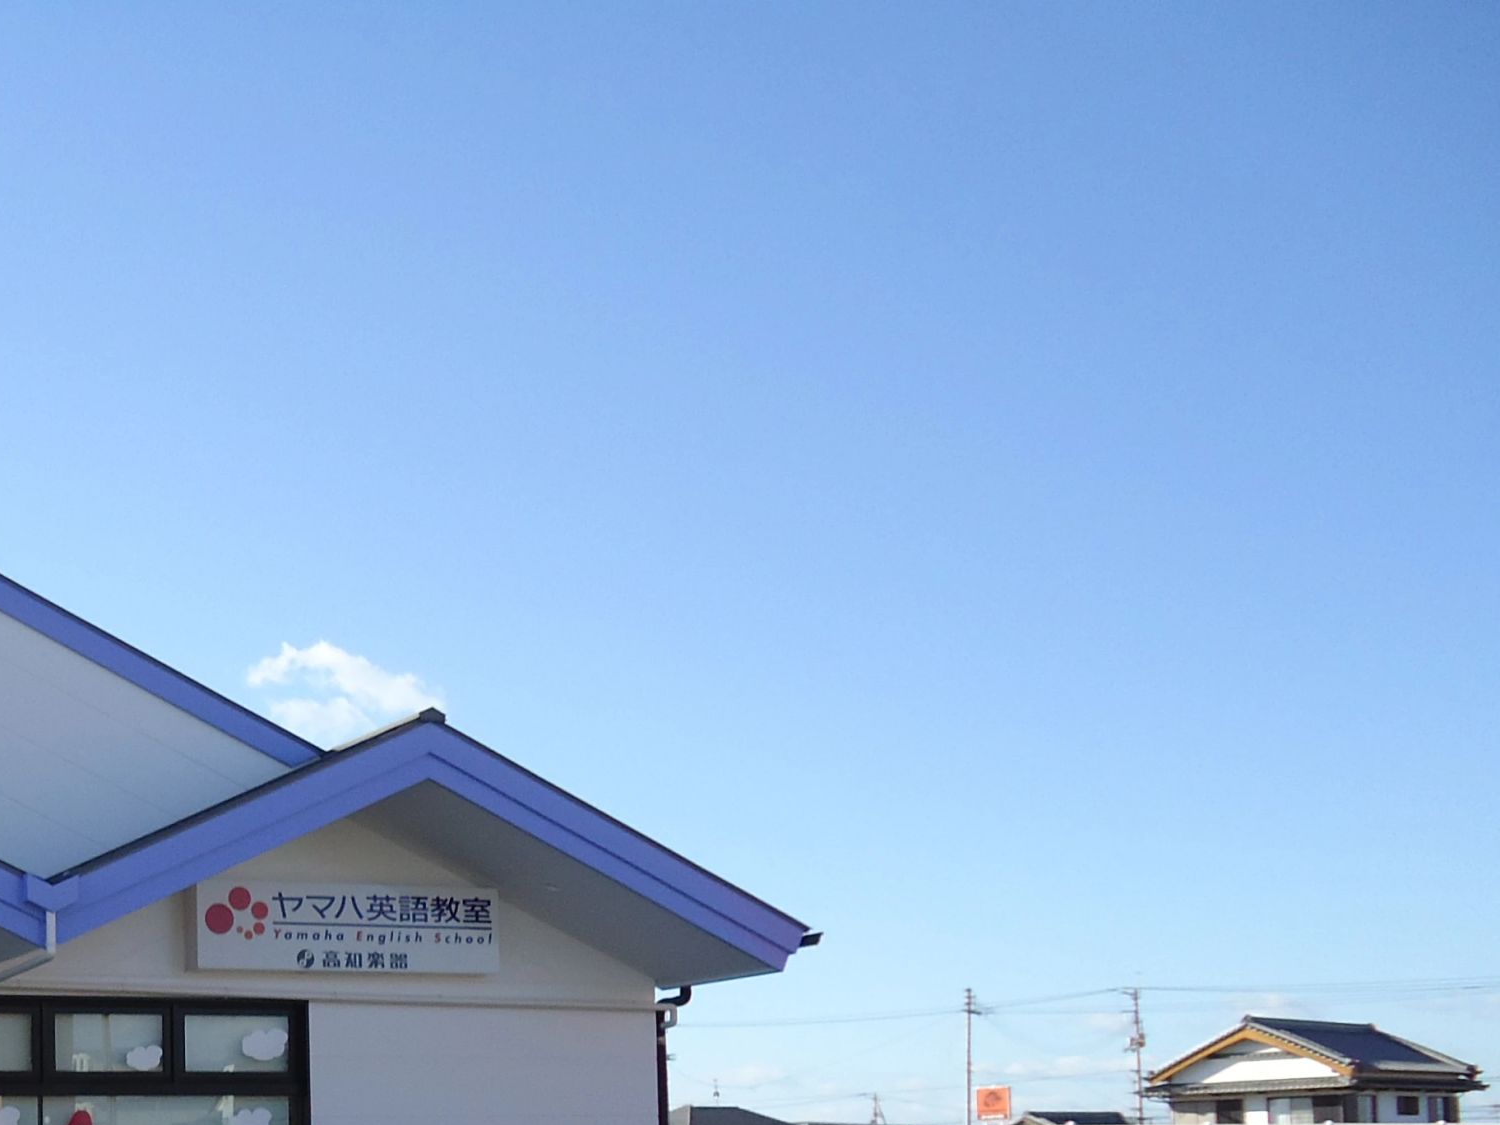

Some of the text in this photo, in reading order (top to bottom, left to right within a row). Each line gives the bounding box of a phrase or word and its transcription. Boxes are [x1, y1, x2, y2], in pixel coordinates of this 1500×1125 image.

[272, 891, 492, 924] ヤマハ英語教室
[273, 929, 493, 945] Yamaha English School
[322, 950, 409, 969] 高知楽器
